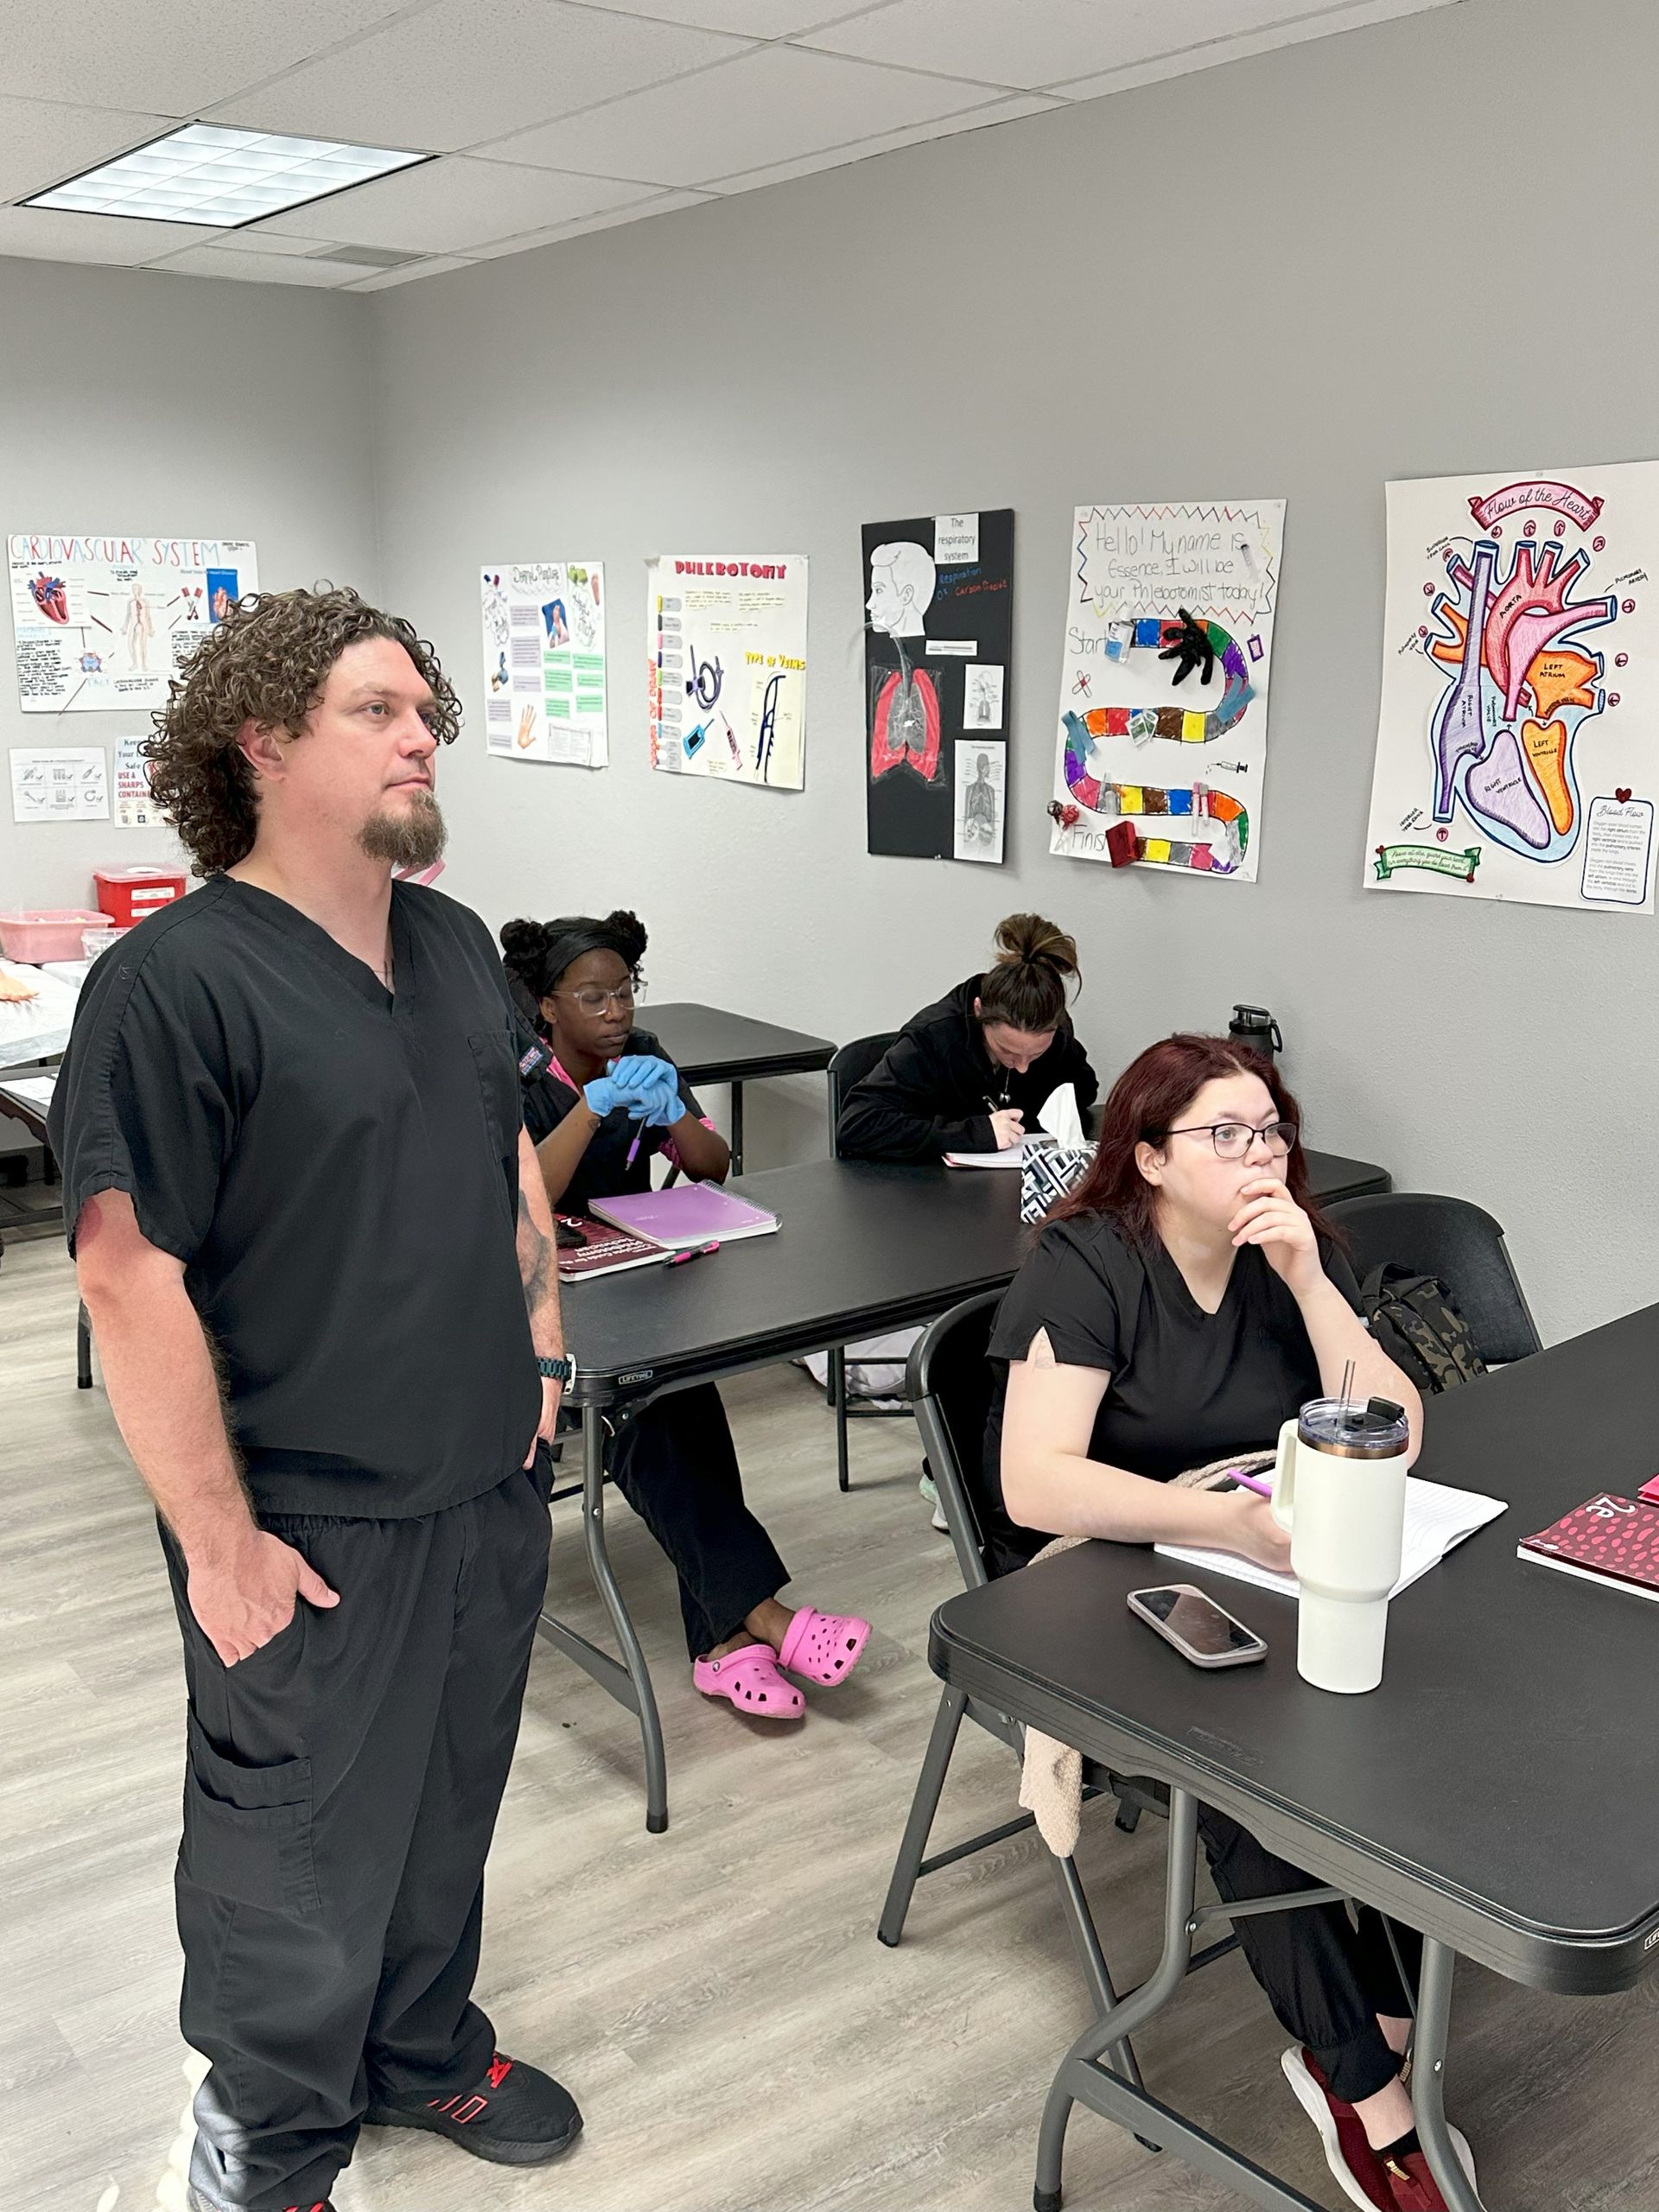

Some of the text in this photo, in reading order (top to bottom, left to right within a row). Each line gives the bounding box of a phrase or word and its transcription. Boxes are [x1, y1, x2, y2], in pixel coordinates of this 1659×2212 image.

[1484, 487, 1592, 521] Flow of the Heart
[951, 518, 964, 527] The
[938, 536, 976, 546] respiratory
[1096, 521, 1144, 555] Hello!
[1152, 530, 1174, 559] My
[1178, 532, 1221, 553] name
[10, 536, 220, 567] CARDIOVASCULAR SYSTEM
[944, 552, 969, 561] system
[1166, 558, 1180, 575] I
[1183, 558, 1210, 574] will
[1216, 559, 1234, 574] be
[1095, 586, 1125, 608] your
[1218, 582, 1264, 608] today!
[1499, 594, 1522, 619] AORTA
[1534, 740, 1549, 748] LEFT
[1484, 778, 1502, 791] RIGHT
[1496, 777, 1522, 794] VENTRICLE
[1597, 804, 1644, 817] Blood Flow
[1586, 1497, 1637, 1518] 2e
